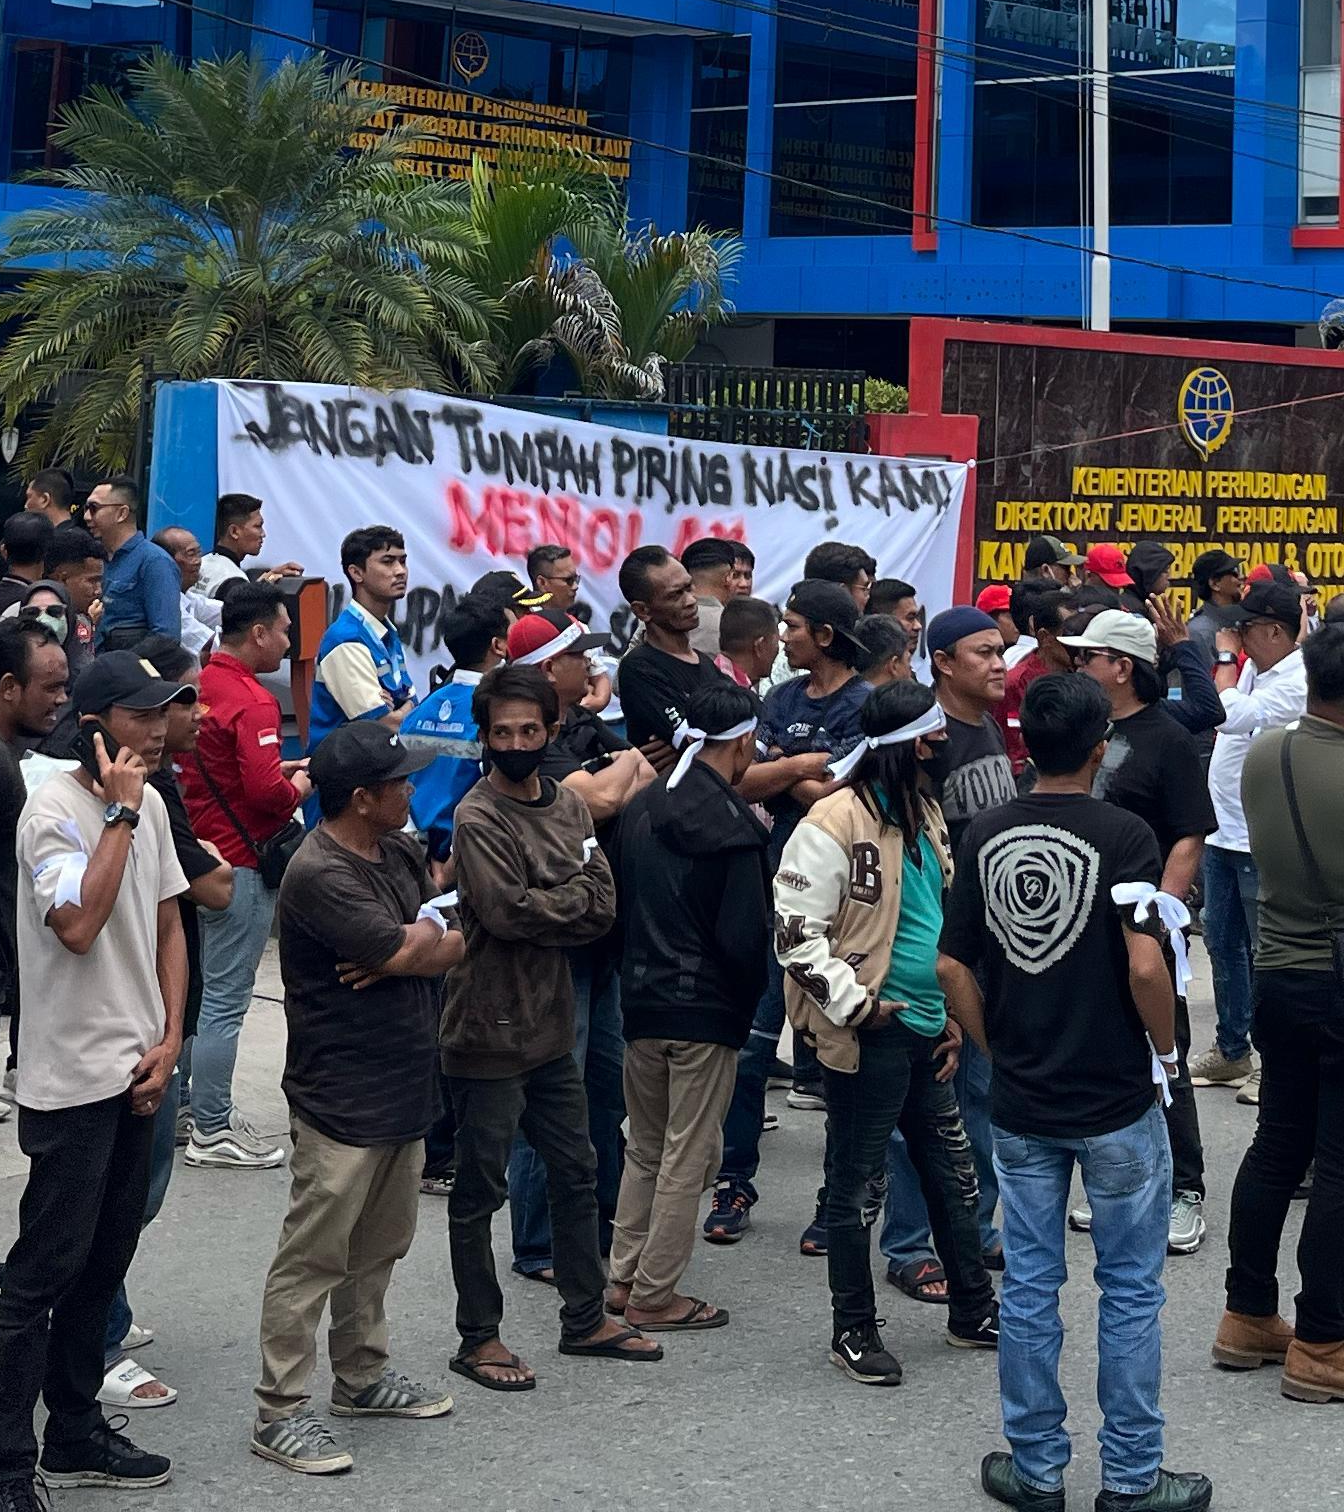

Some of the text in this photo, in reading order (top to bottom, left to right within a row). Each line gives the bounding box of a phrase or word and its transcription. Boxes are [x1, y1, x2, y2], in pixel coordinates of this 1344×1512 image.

[596, 137, 632, 159] LAUT
[435, 403, 601, 496] TUMPAH
[1072, 466, 1327, 501] KEMENTERIAN PERHUBUNGAN
[995, 500, 1114, 532] DIREKTORAT
[1116, 503, 1207, 533] JENDERAL
[1216, 506, 1338, 535] PERHUBUNGAN
[1284, 542, 1299, 572] &
[851, 840, 883, 907] B
